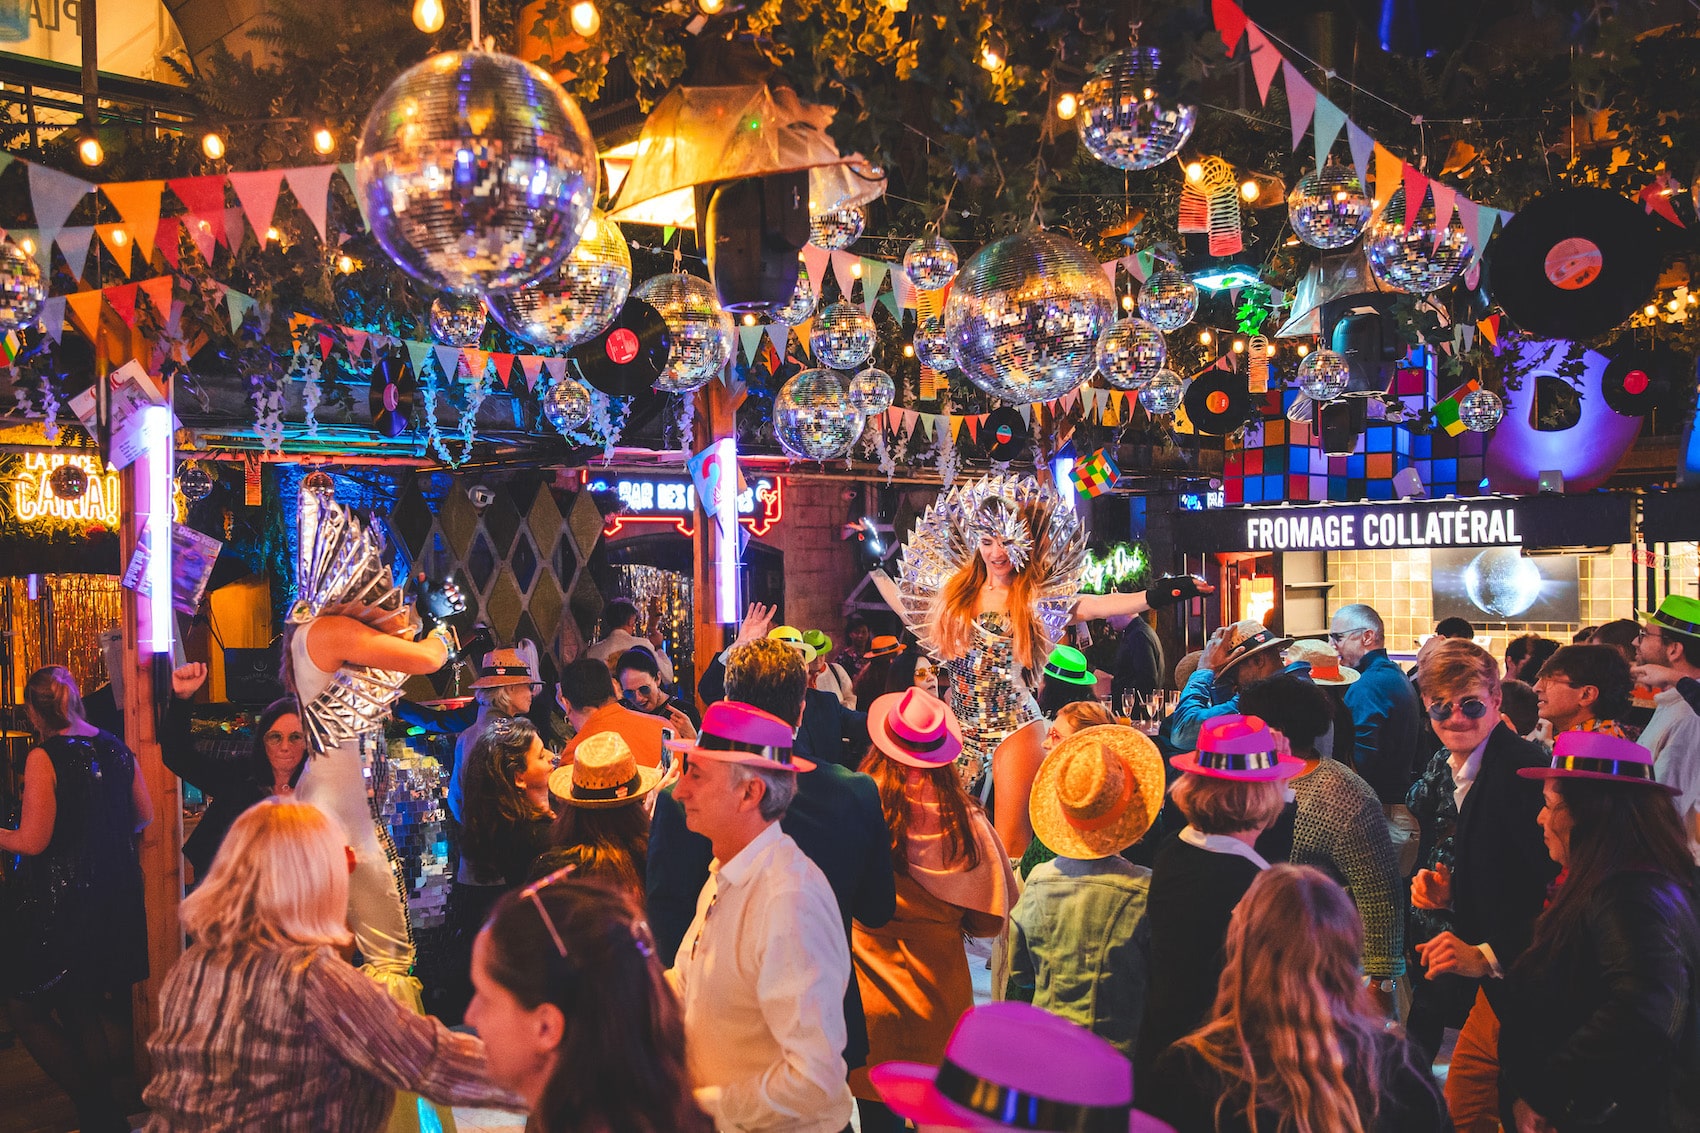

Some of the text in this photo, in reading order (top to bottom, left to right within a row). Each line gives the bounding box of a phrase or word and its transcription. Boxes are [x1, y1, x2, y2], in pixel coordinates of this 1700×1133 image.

[25, 452, 48, 470] LA
[618, 481, 653, 510] BAR
[657, 483, 686, 510] DES
[178, 525, 201, 543] Disco
[1247, 505, 1523, 549] FROMAGE COLLATÉRAL
